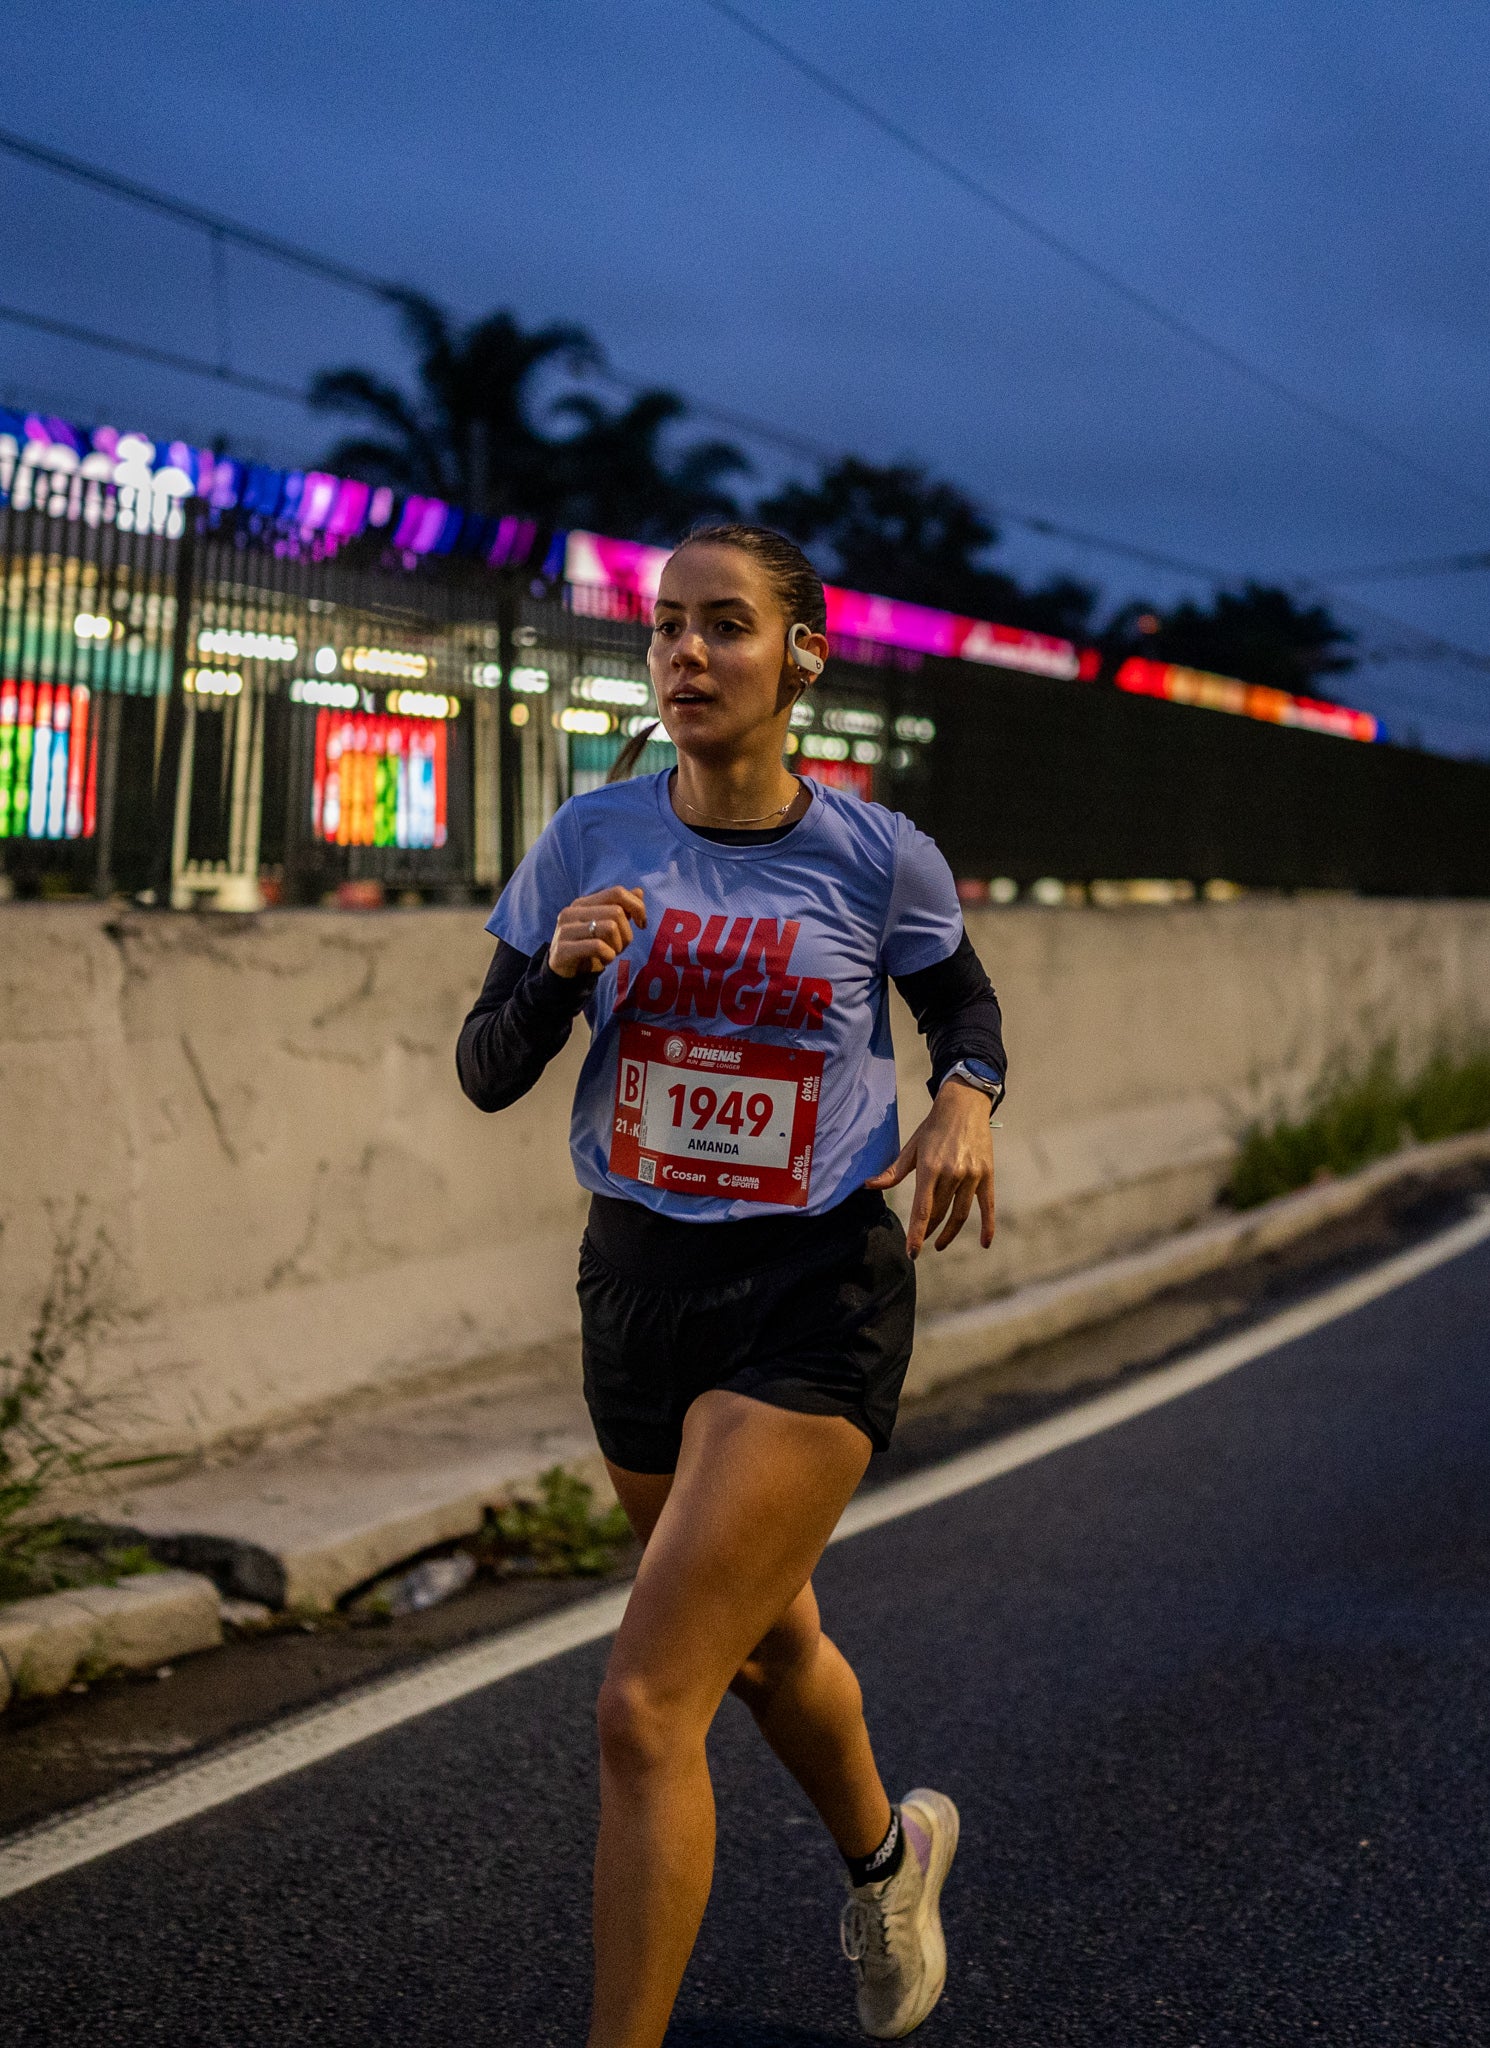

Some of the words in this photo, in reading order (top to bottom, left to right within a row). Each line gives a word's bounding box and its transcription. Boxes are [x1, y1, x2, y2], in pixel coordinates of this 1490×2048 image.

[648, 908, 801, 976] RUN
[689, 1046, 743, 1063] ATHENAS
[716, 1062, 741, 1070] LONGER
[624, 1064, 640, 1103] B
[801, 1076, 813, 1102] 1949
[667, 1083, 774, 1138] 1949
[687, 1138, 740, 1155] AMANDA
[671, 1170, 706, 1183] cosan
[791, 1155, 804, 1181] 1949
[730, 1181, 760, 1190] SPORTS
[731, 1175, 760, 1184] IGUANA
